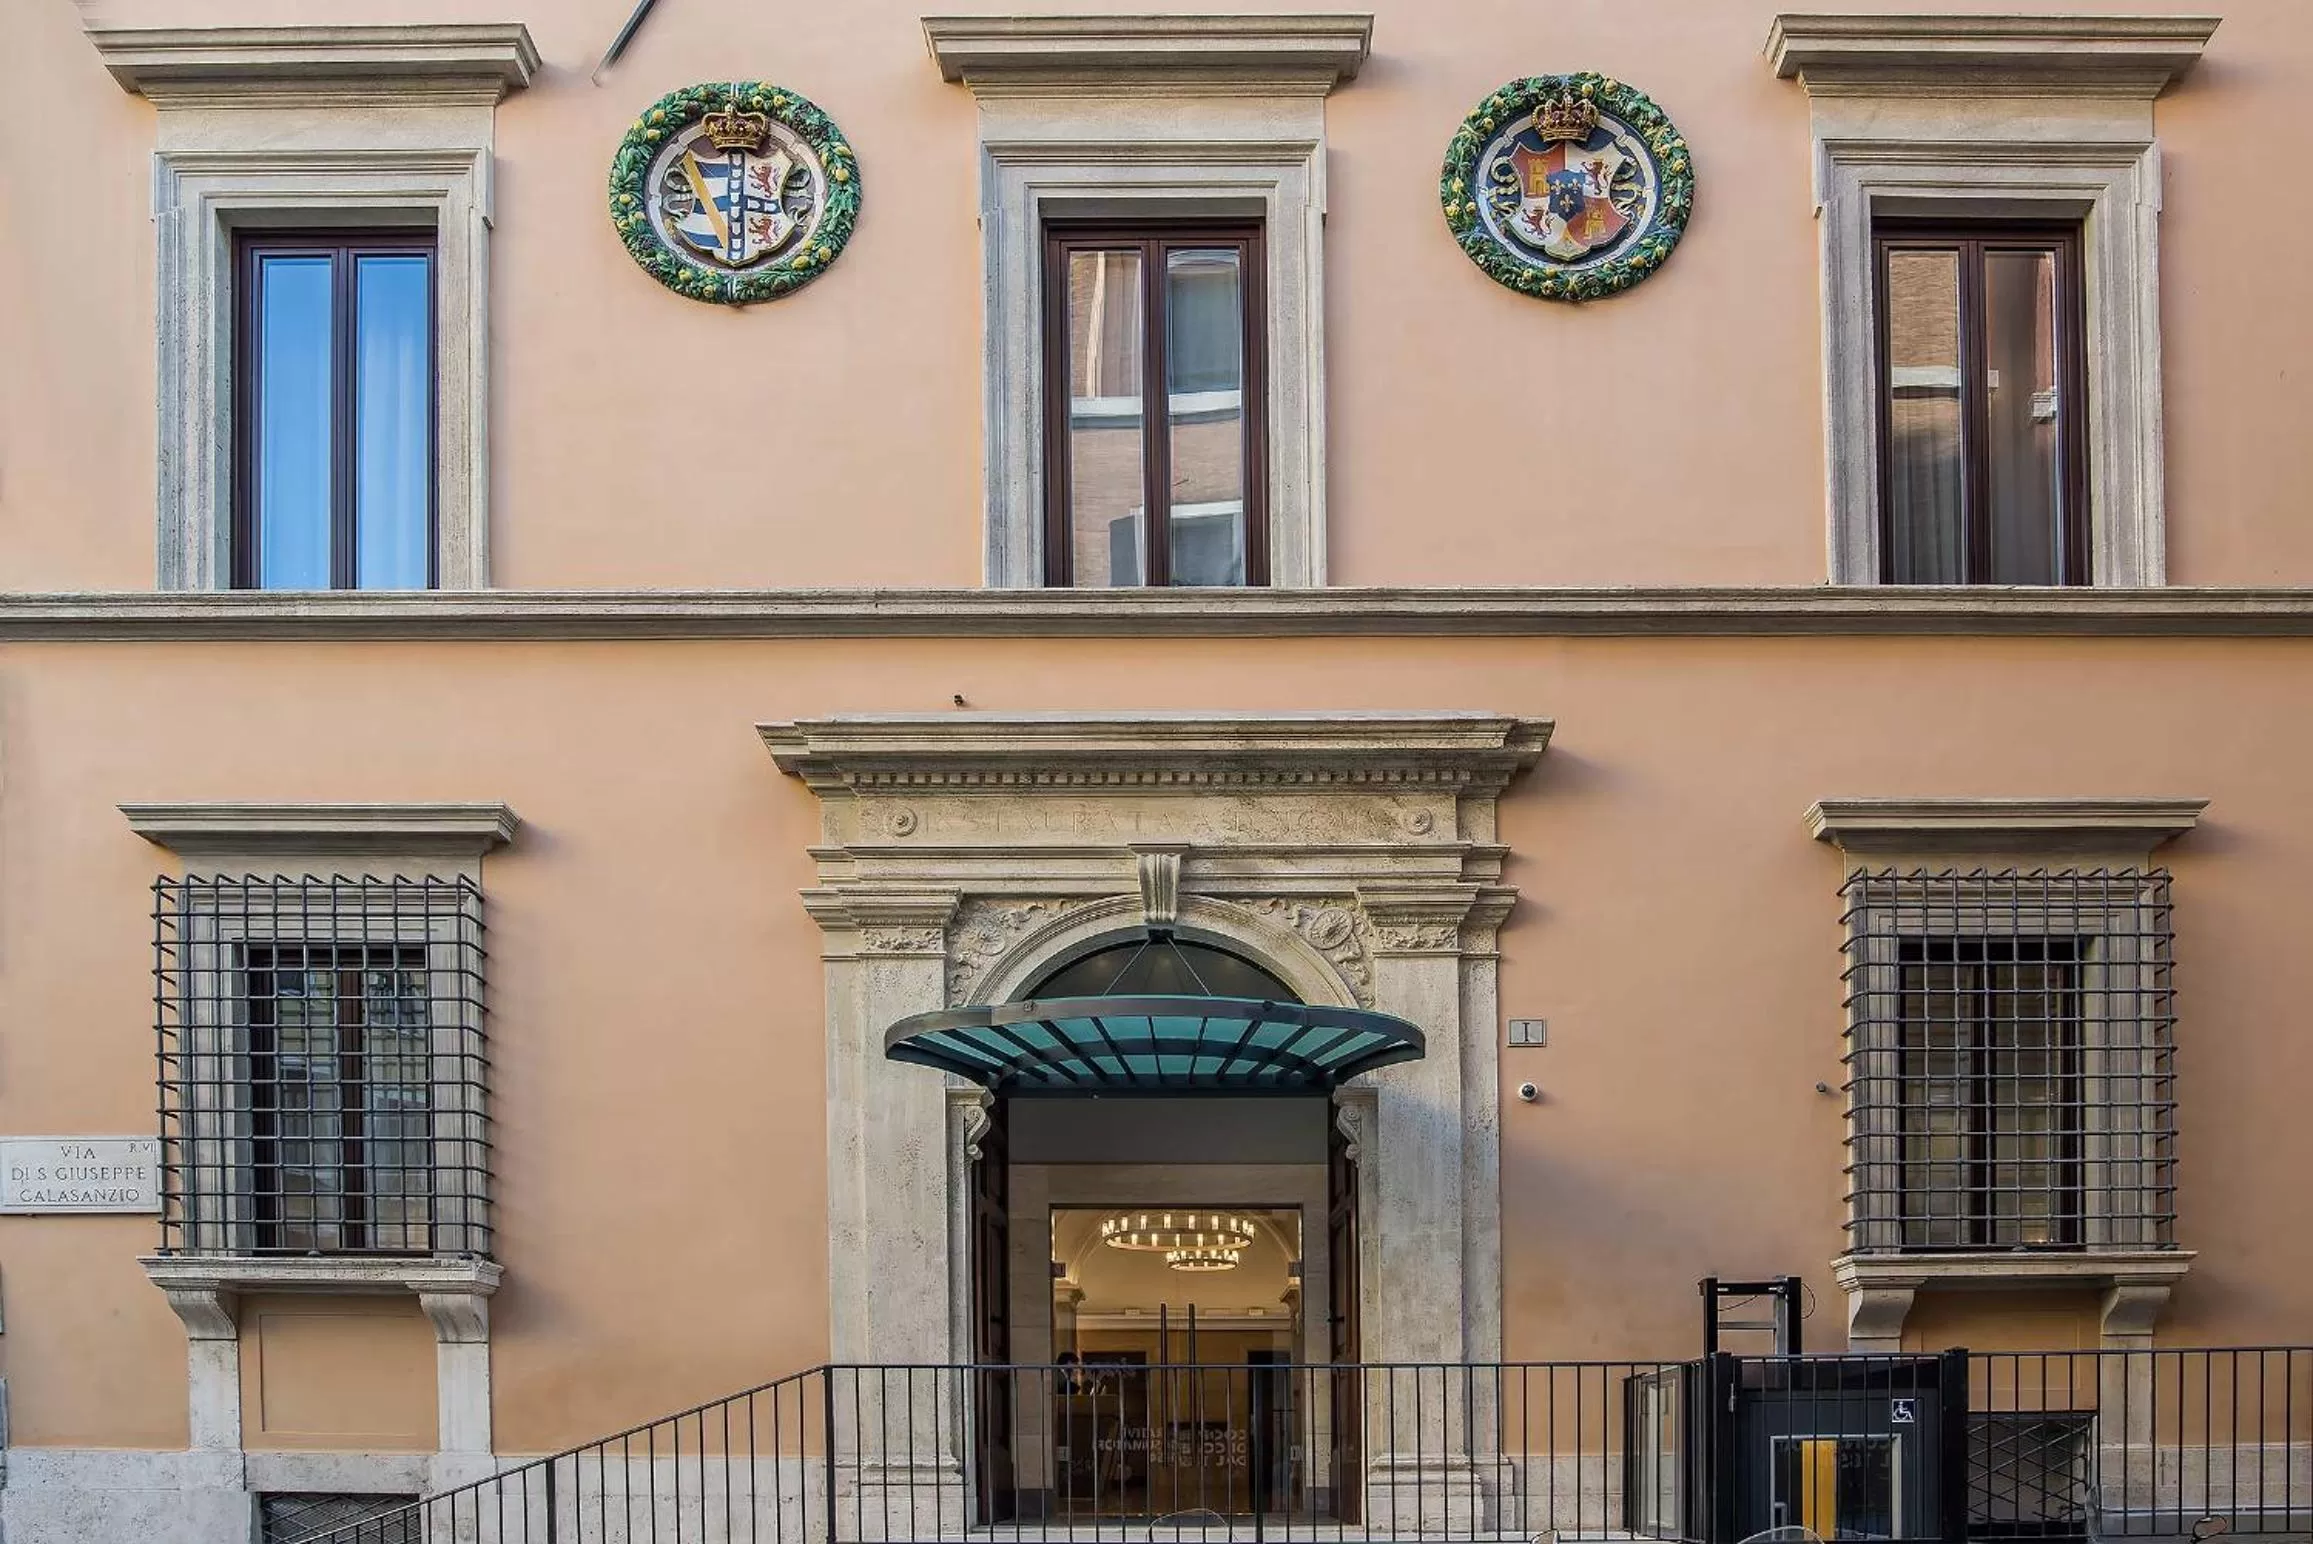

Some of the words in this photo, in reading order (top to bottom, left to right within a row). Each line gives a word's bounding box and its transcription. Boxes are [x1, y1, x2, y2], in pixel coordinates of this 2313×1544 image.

[60, 1145, 96, 1159] VIA
[11, 1167, 29, 1181] DI
[55, 1167, 147, 1181] GIUSEPPE
[19, 1189, 140, 1202] CALASANZIO
